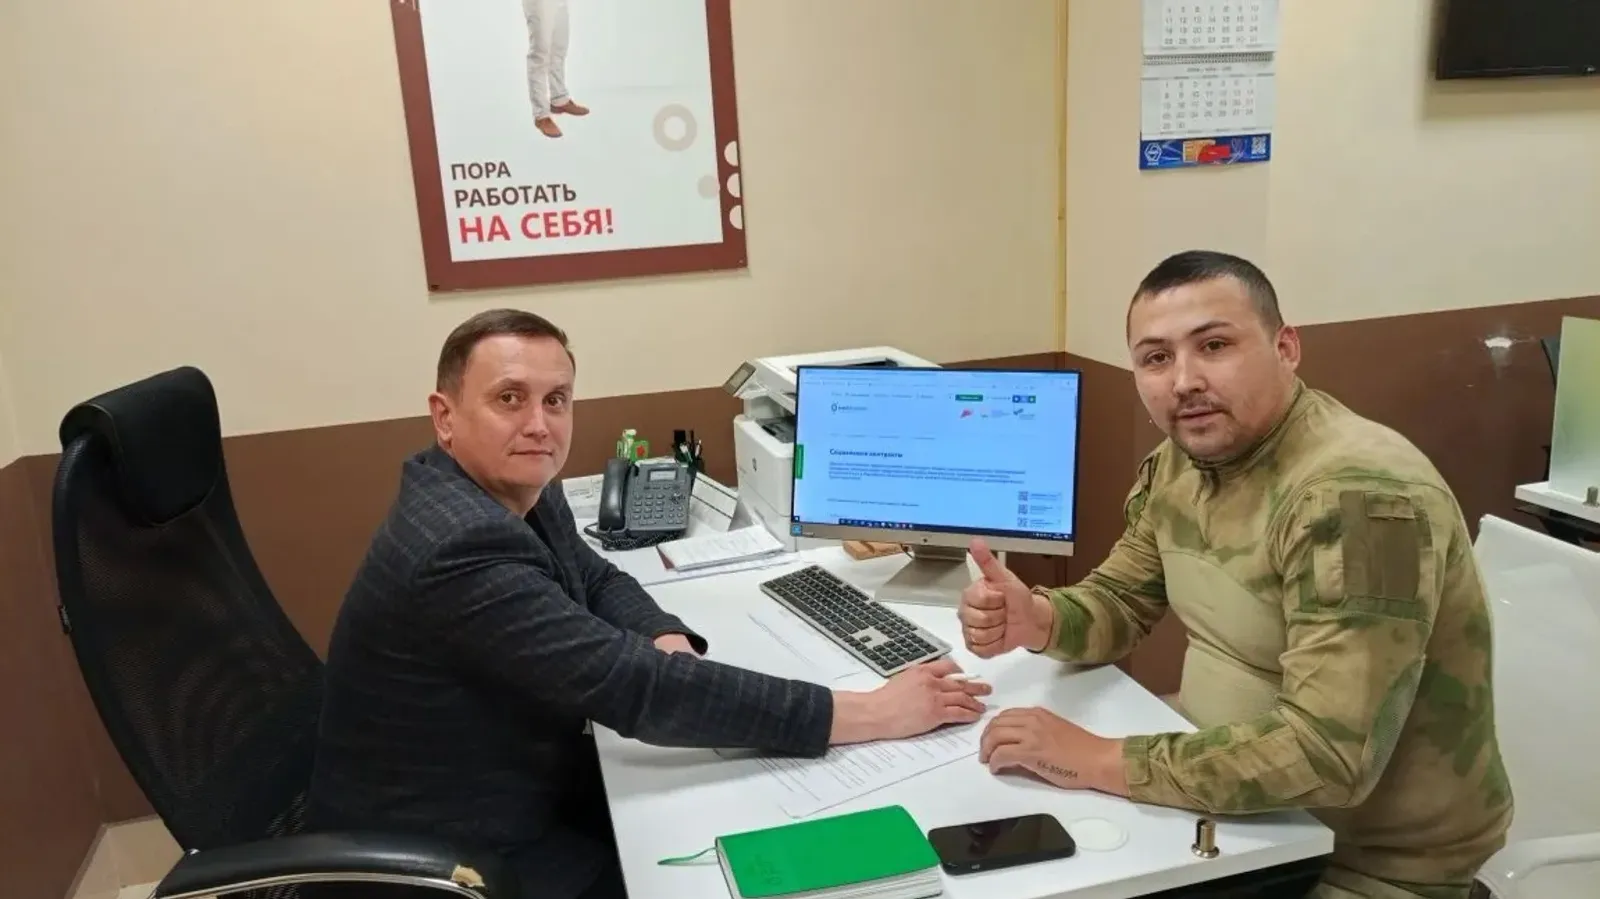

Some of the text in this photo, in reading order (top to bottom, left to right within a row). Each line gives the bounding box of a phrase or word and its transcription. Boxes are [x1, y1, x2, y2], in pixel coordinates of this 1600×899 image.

[451, 161, 511, 181] ПОРА
[454, 183, 577, 208] РАБОТАТЬ
[458, 208, 614, 243] НА СЕБЯ!
